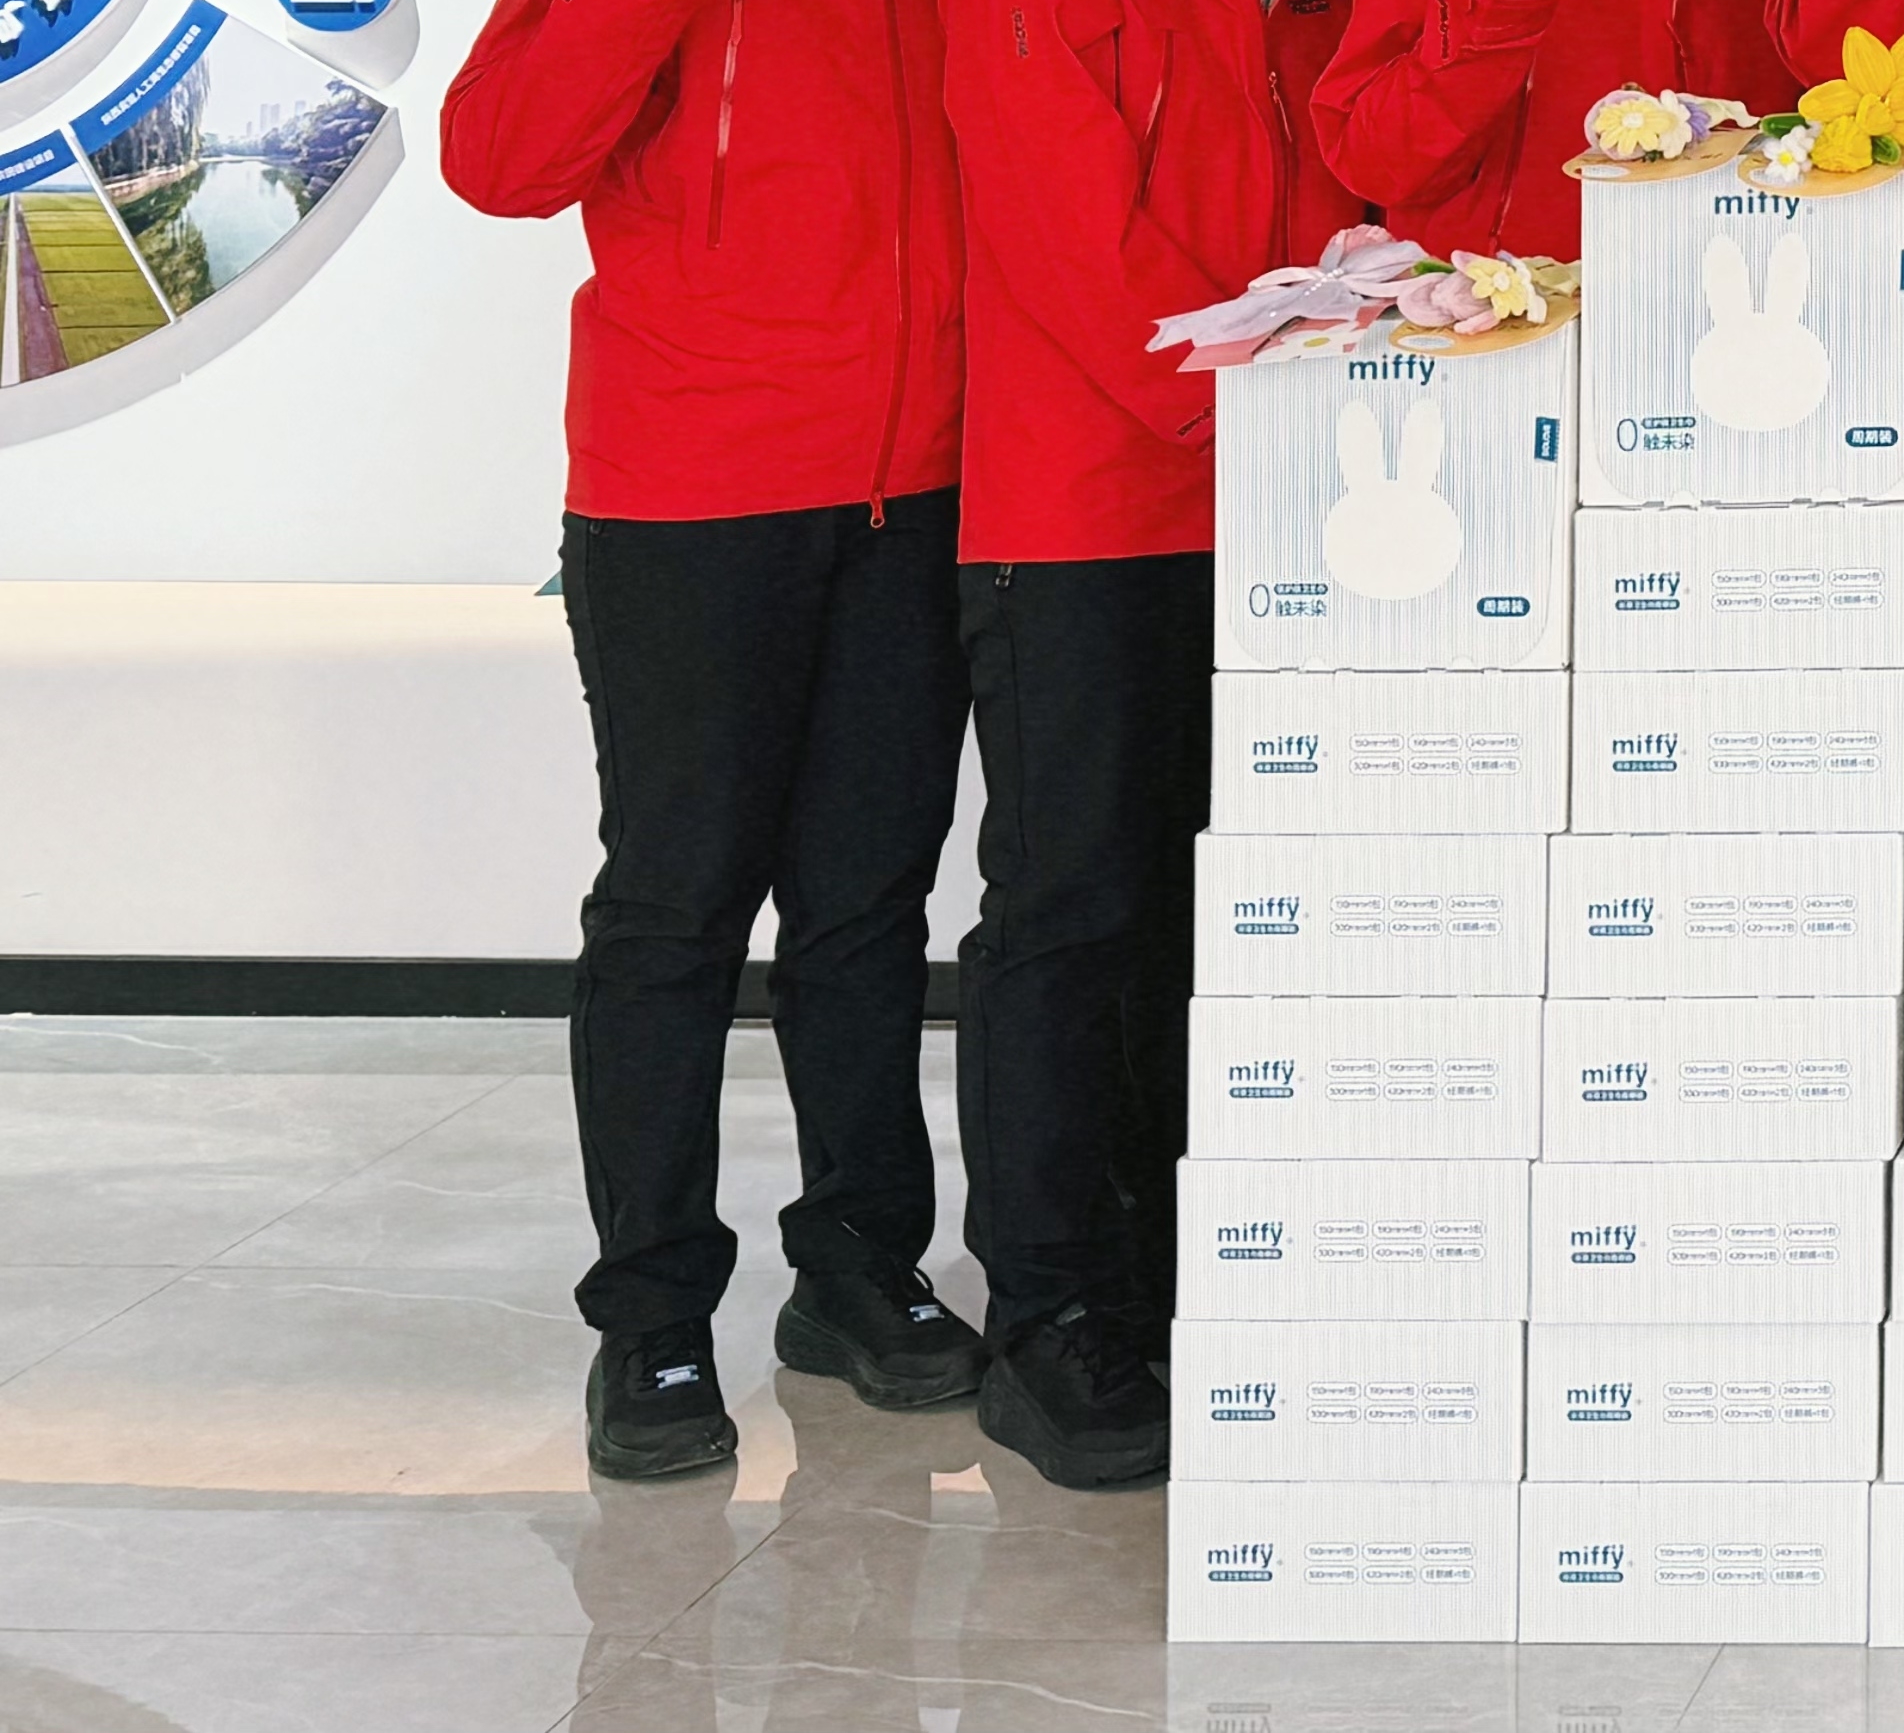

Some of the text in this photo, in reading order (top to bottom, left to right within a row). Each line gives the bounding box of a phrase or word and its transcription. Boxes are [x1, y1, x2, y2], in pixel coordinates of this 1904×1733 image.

[1349, 356, 1435, 386] miffy
[1615, 571, 1681, 597] miffy
[1253, 734, 1319, 761] miffy
[1612, 733, 1678, 759] miffy
[1234, 896, 1300, 922] miffy
[1588, 897, 1654, 923] miffy
[1229, 1059, 1295, 1086] miffy
[1582, 1062, 1648, 1089] miffy
[1217, 1221, 1283, 1247] miffy
[1571, 1225, 1636, 1251] miffy
[1210, 1383, 1276, 1409] miffy
[1567, 1383, 1633, 1408] miffy
[1208, 1543, 1274, 1569] miffy
[1559, 1544, 1624, 1570] miffy
